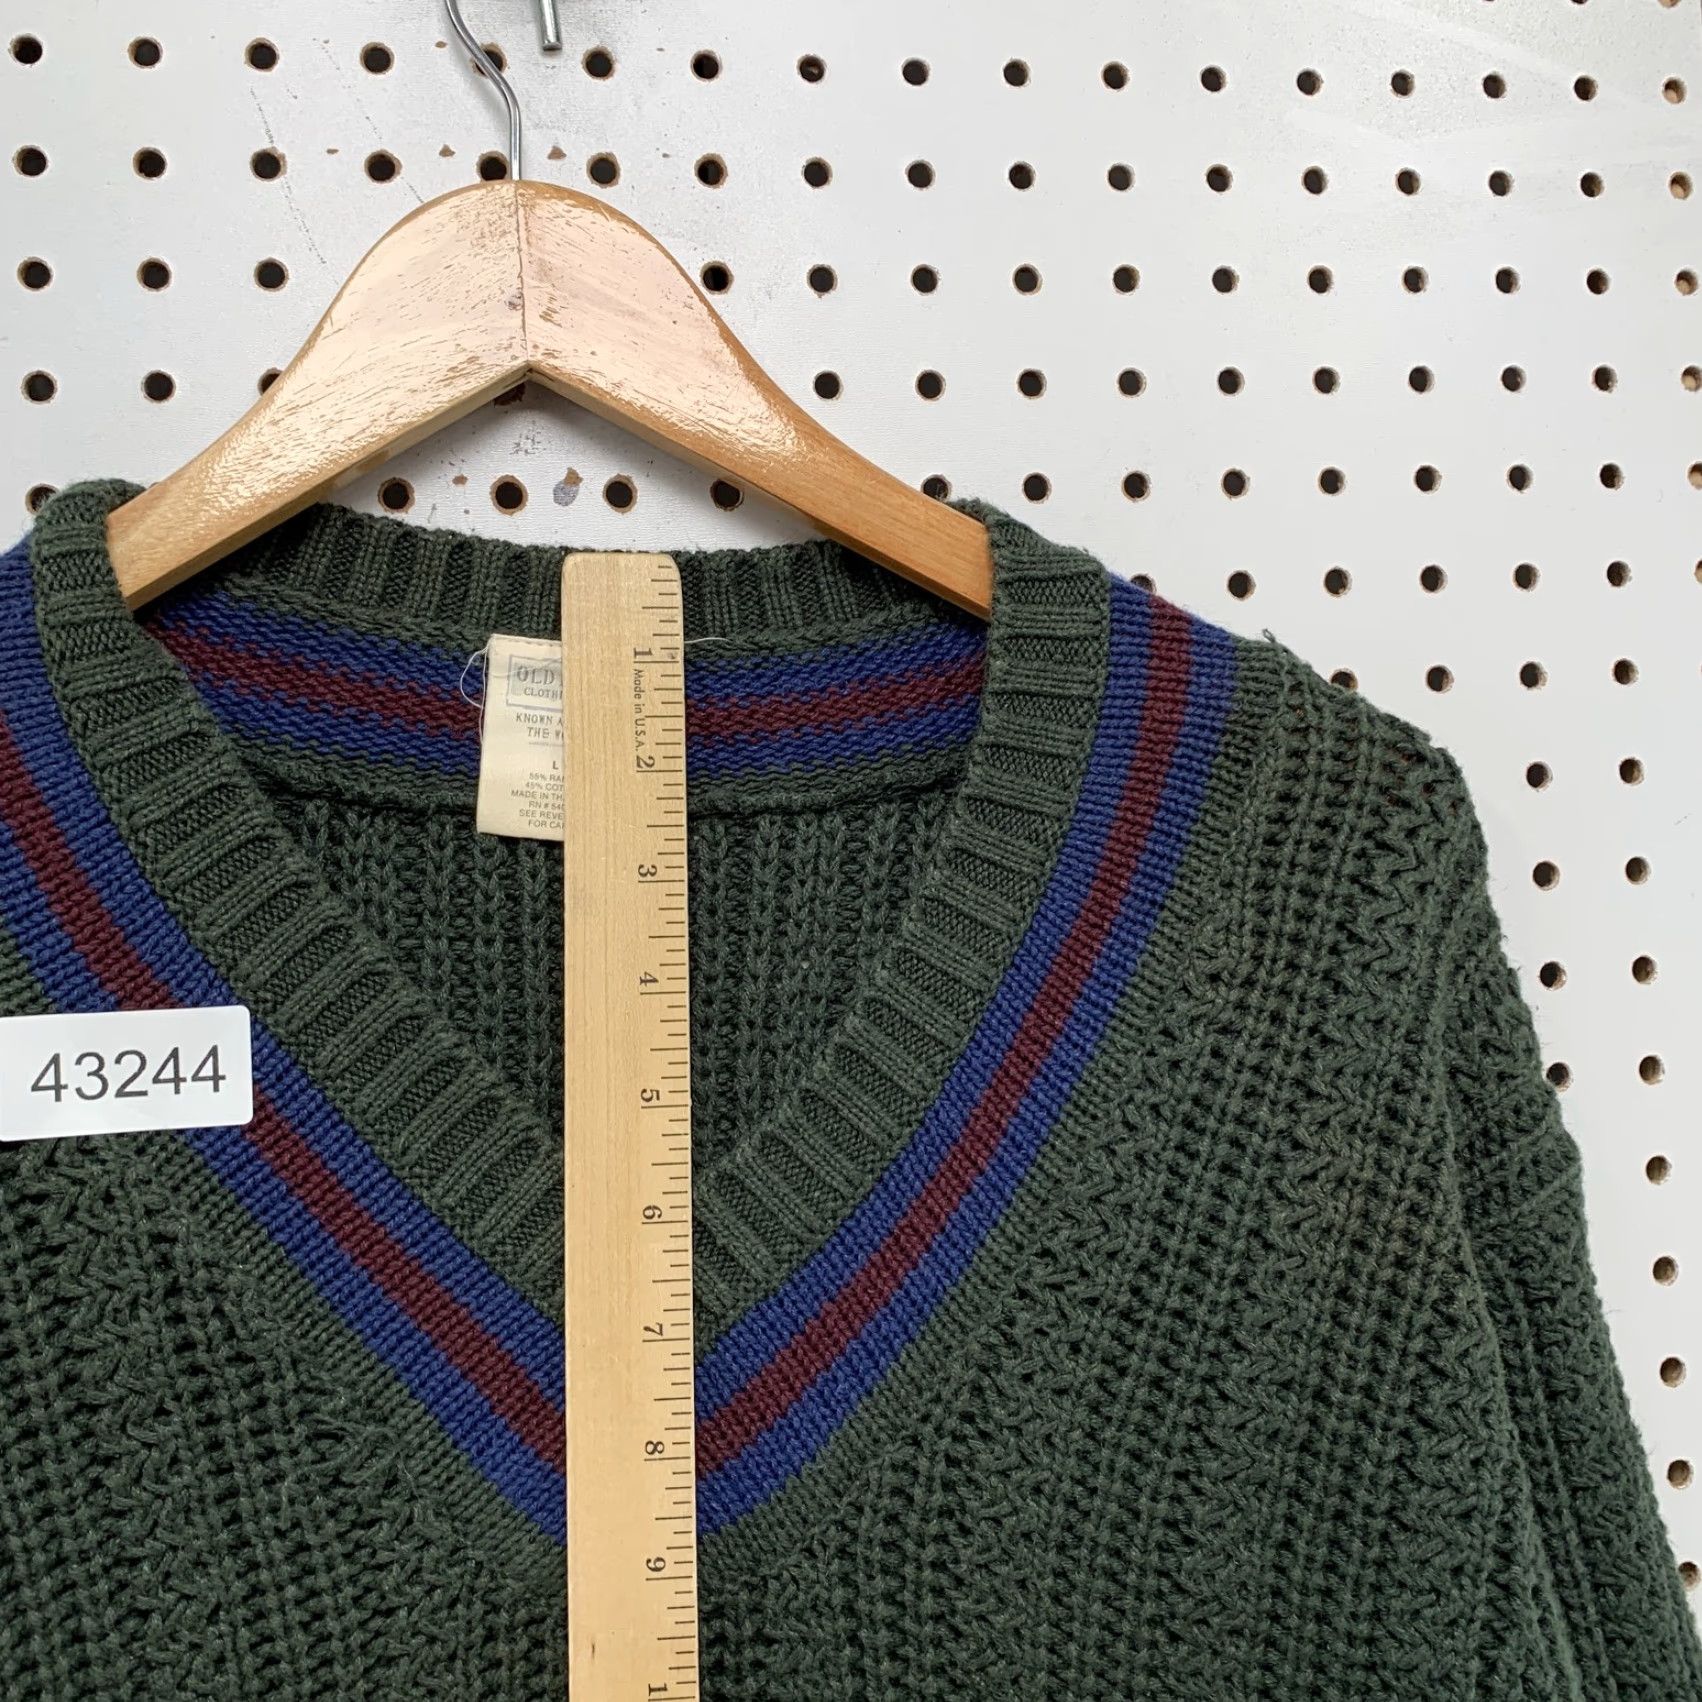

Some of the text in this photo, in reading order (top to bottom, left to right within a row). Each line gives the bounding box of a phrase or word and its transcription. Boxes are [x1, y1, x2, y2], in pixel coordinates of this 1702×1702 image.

[633, 647, 653, 659] 1
[516, 665, 555, 685] OLD
[633, 668, 647, 752] Made in U.S.A.
[515, 712, 553, 725] KNOWN
[527, 726, 550, 739] THE
[552, 760, 560, 770] L
[636, 755, 656, 769] 2
[510, 789, 564, 802] MADE IN TH
[528, 800, 541, 809] RN
[519, 809, 537, 818] SEE
[528, 820, 547, 828] FOR
[638, 864, 658, 878] 3
[639, 971, 659, 986] 4
[31, 1044, 227, 1102] 43244
[640, 1088, 660, 1102] 5
[642, 1205, 662, 1220] 6
[643, 1322, 664, 1337] 7
[645, 1440, 665, 1455] 8
[646, 1557, 666, 1572] 9
